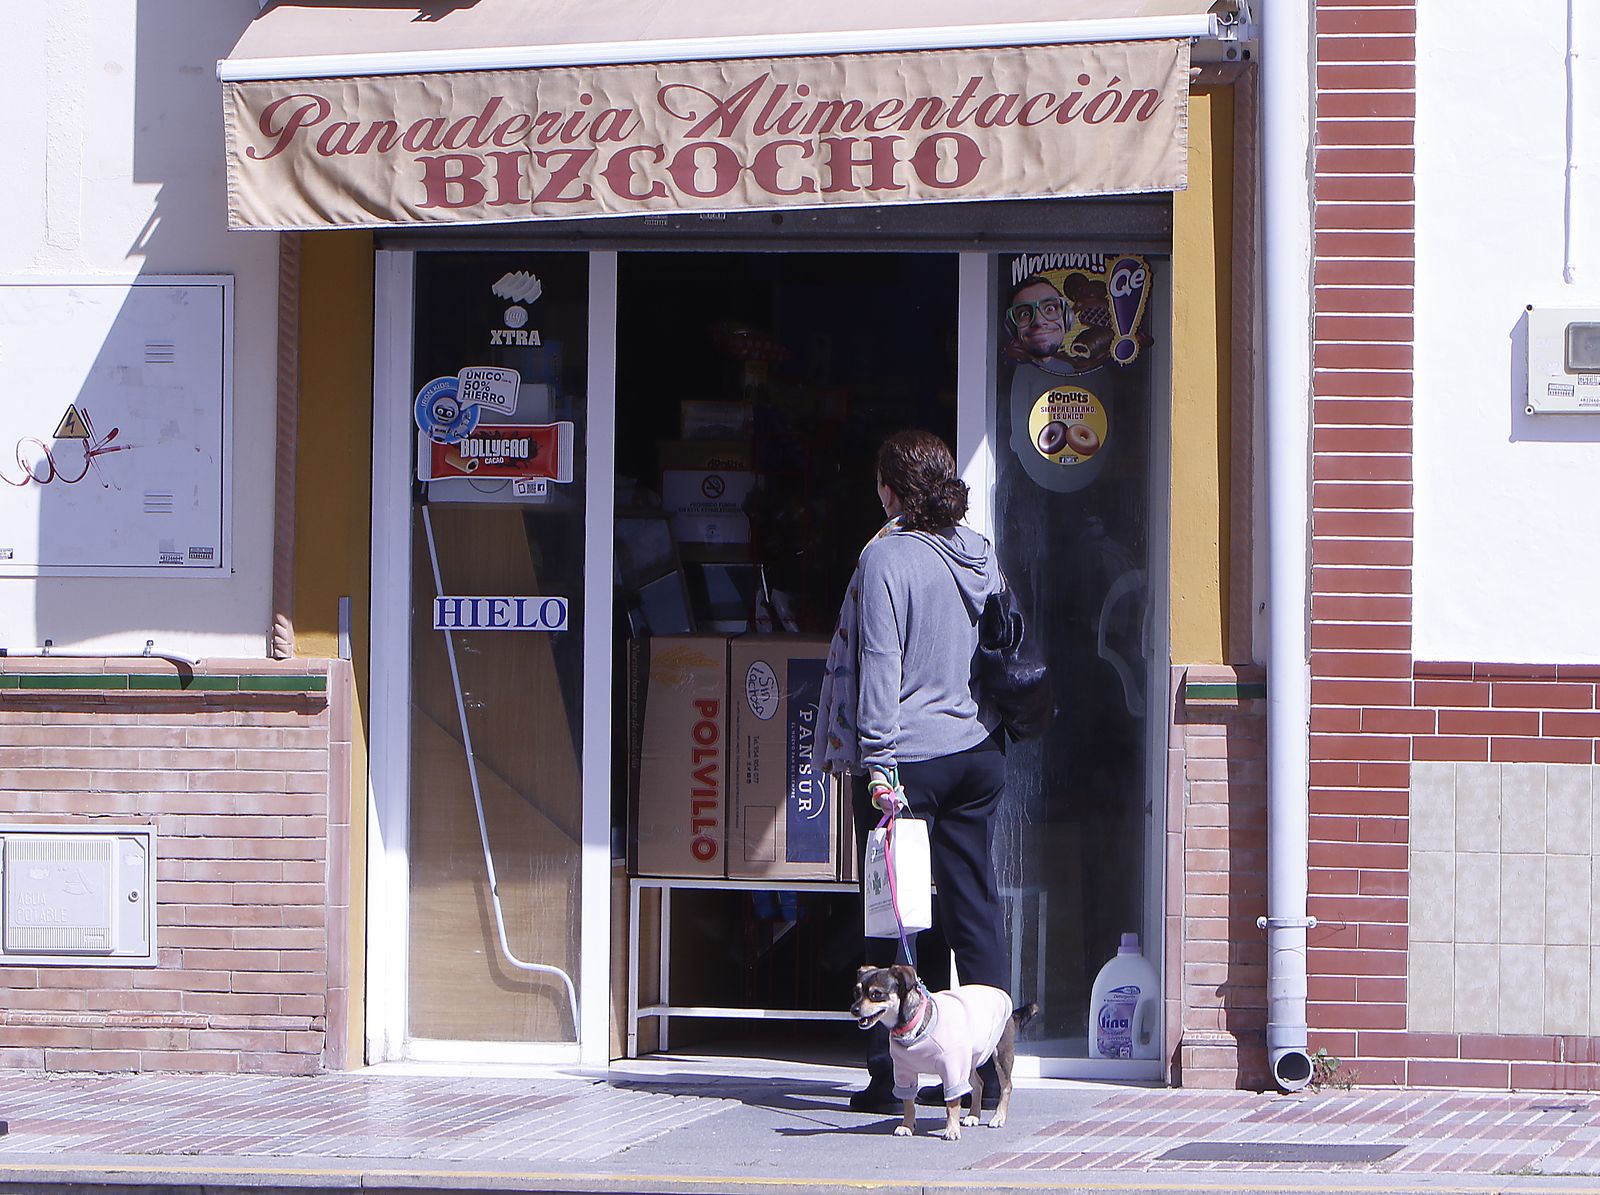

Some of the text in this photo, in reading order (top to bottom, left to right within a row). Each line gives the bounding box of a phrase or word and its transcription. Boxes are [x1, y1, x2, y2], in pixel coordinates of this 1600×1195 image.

[657, 71, 1166, 139] Alimentación
[414, 132, 988, 209] BIZCOCHO
[490, 329, 541, 346] XTRA
[462, 390, 506, 405] HIERRO
[464, 380, 491, 392] 50%
[1047, 391, 1089, 404] donuts
[1040, 405, 1070, 413] SIEMPRE
[460, 438, 531, 458] BOLLYCAO
[437, 599, 565, 628] HIELO
[747, 667, 766, 717] Lactosa
[758, 676, 775, 703] Sin
[798, 709, 814, 813] PANSUR
[690, 699, 720, 862] POLVILLO
